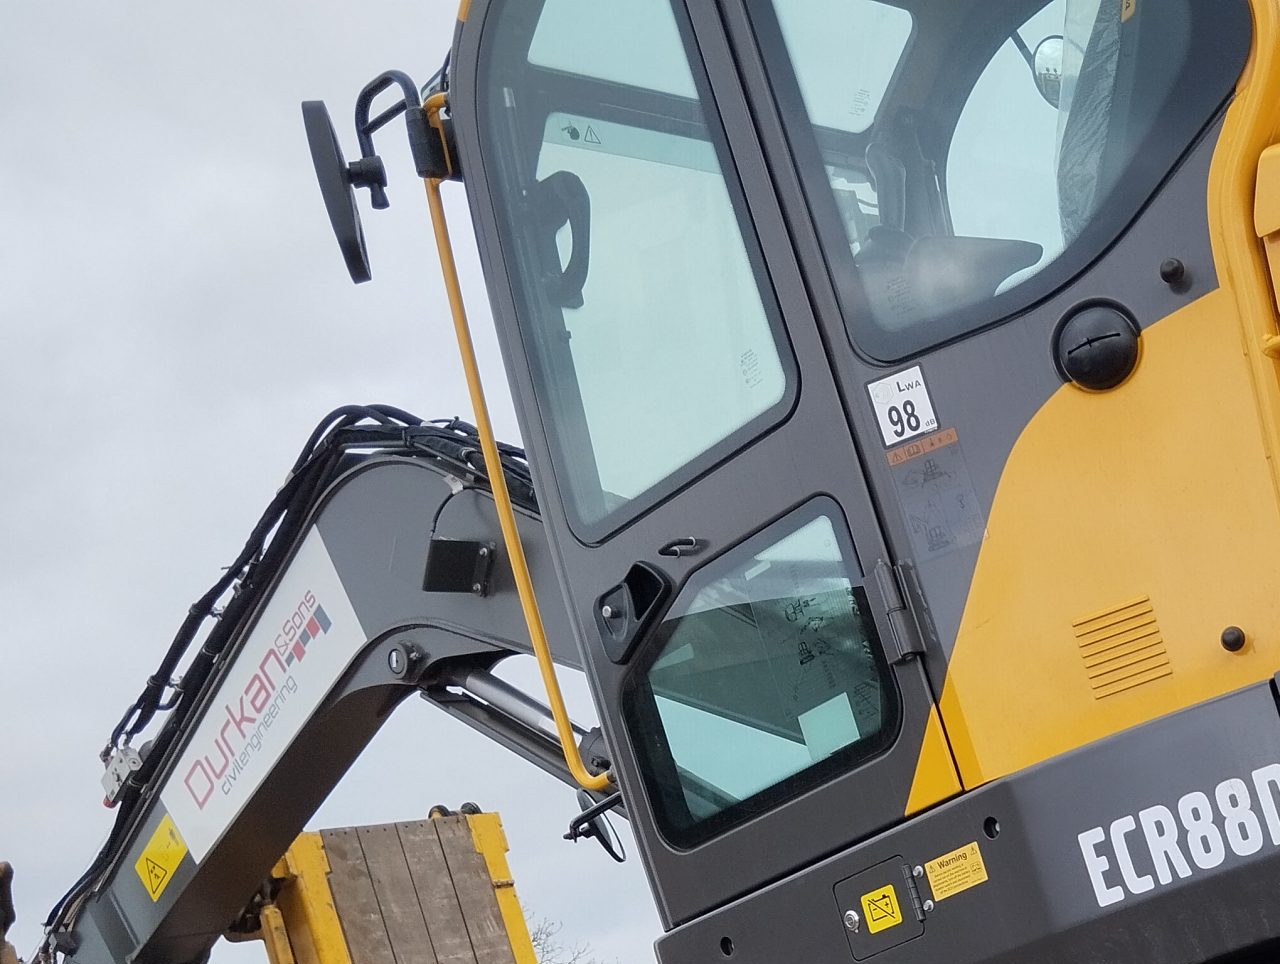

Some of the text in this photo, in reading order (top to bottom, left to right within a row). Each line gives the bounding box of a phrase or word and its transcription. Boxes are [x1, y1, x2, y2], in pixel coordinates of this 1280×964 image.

[887, 399, 921, 438] 98
[924, 418, 936, 427] dB
[184, 648, 287, 811] Durkan
[936, 852, 969, 870] Warning
